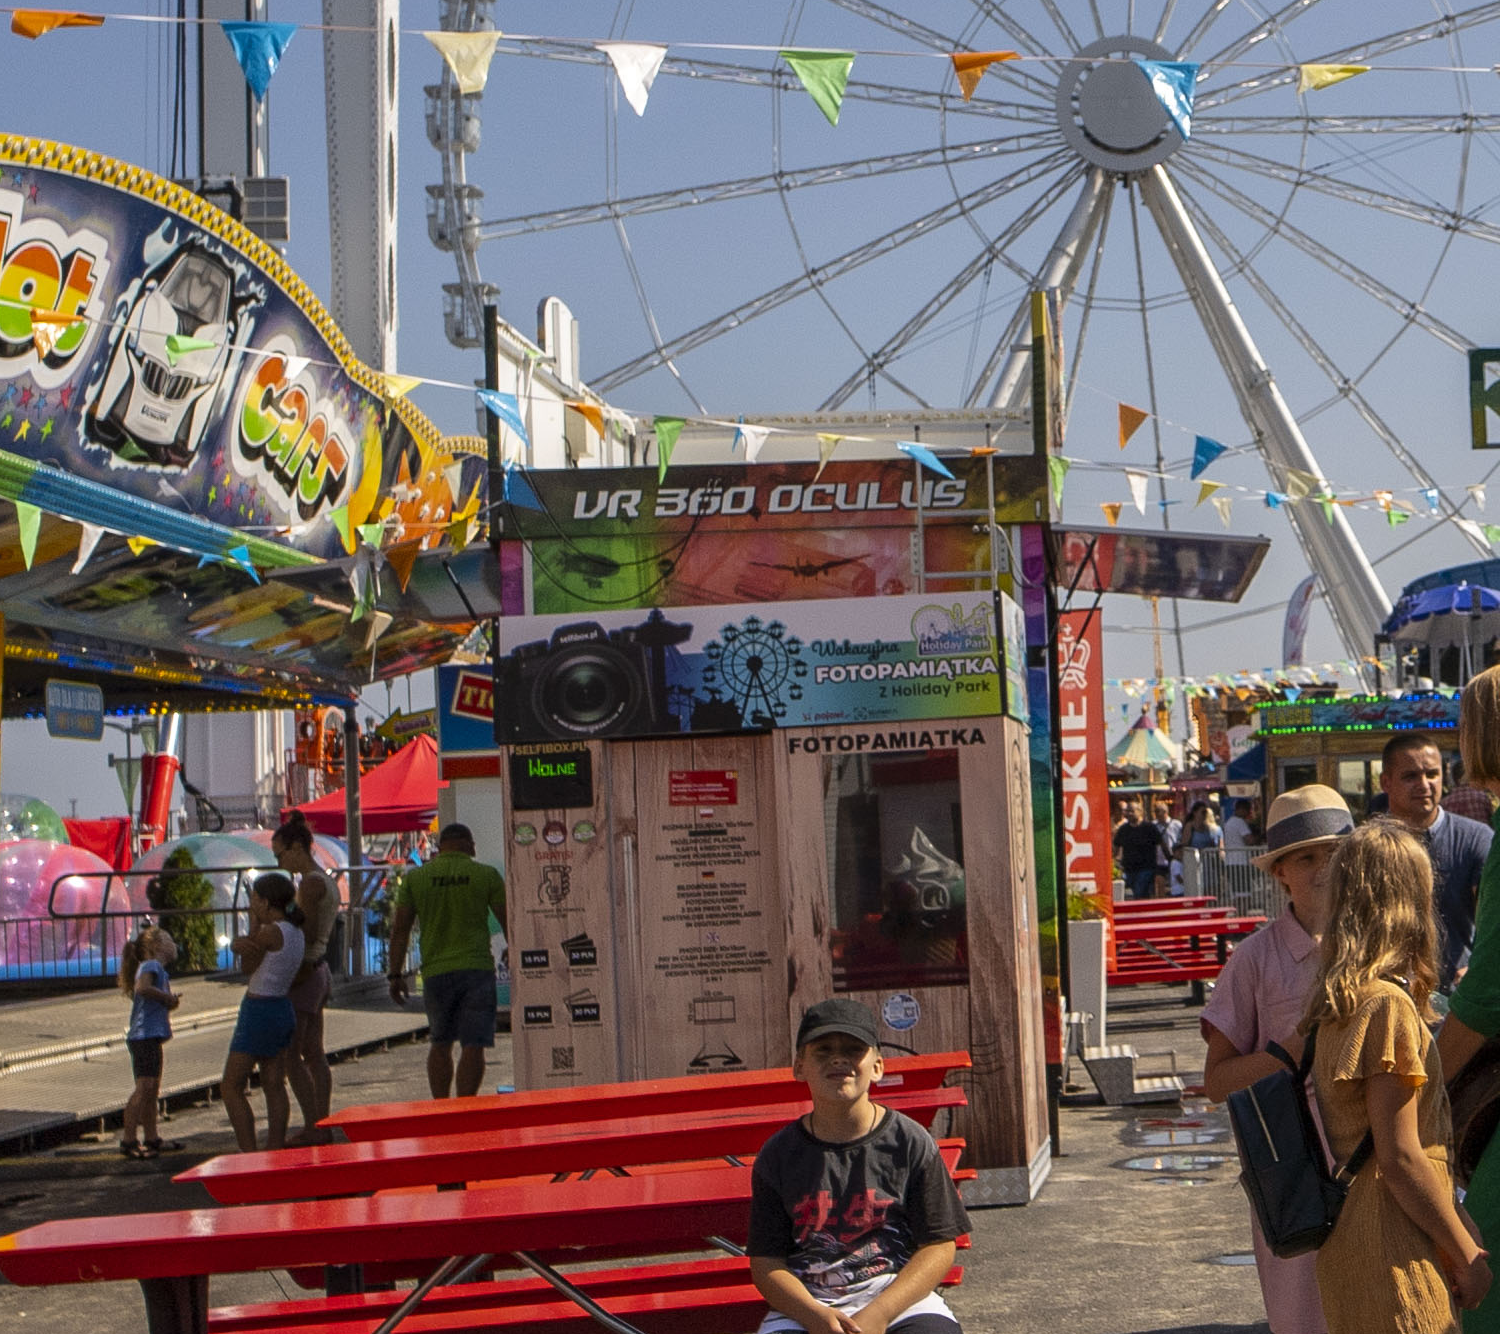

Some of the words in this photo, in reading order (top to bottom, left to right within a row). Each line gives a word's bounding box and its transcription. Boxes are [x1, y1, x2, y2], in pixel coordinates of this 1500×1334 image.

[240, 355, 351, 502] Cars
[573, 489, 643, 519] VR
[654, 485, 757, 517] 360
[768, 480, 967, 515] OCULUS
[811, 638, 901, 661] Wakacyjna
[921, 640, 962, 652] Holiday
[964, 638, 990, 650] Park
[815, 656, 998, 685] FOTOPAMIĄTKA
[892, 682, 951, 698] Holiday
[956, 680, 991, 693] Park
[515, 742, 587, 755] SELFIBOX.PL
[789, 729, 986, 754] FOTOPAMIĄTKA
[432, 875, 470, 887] TEAM
